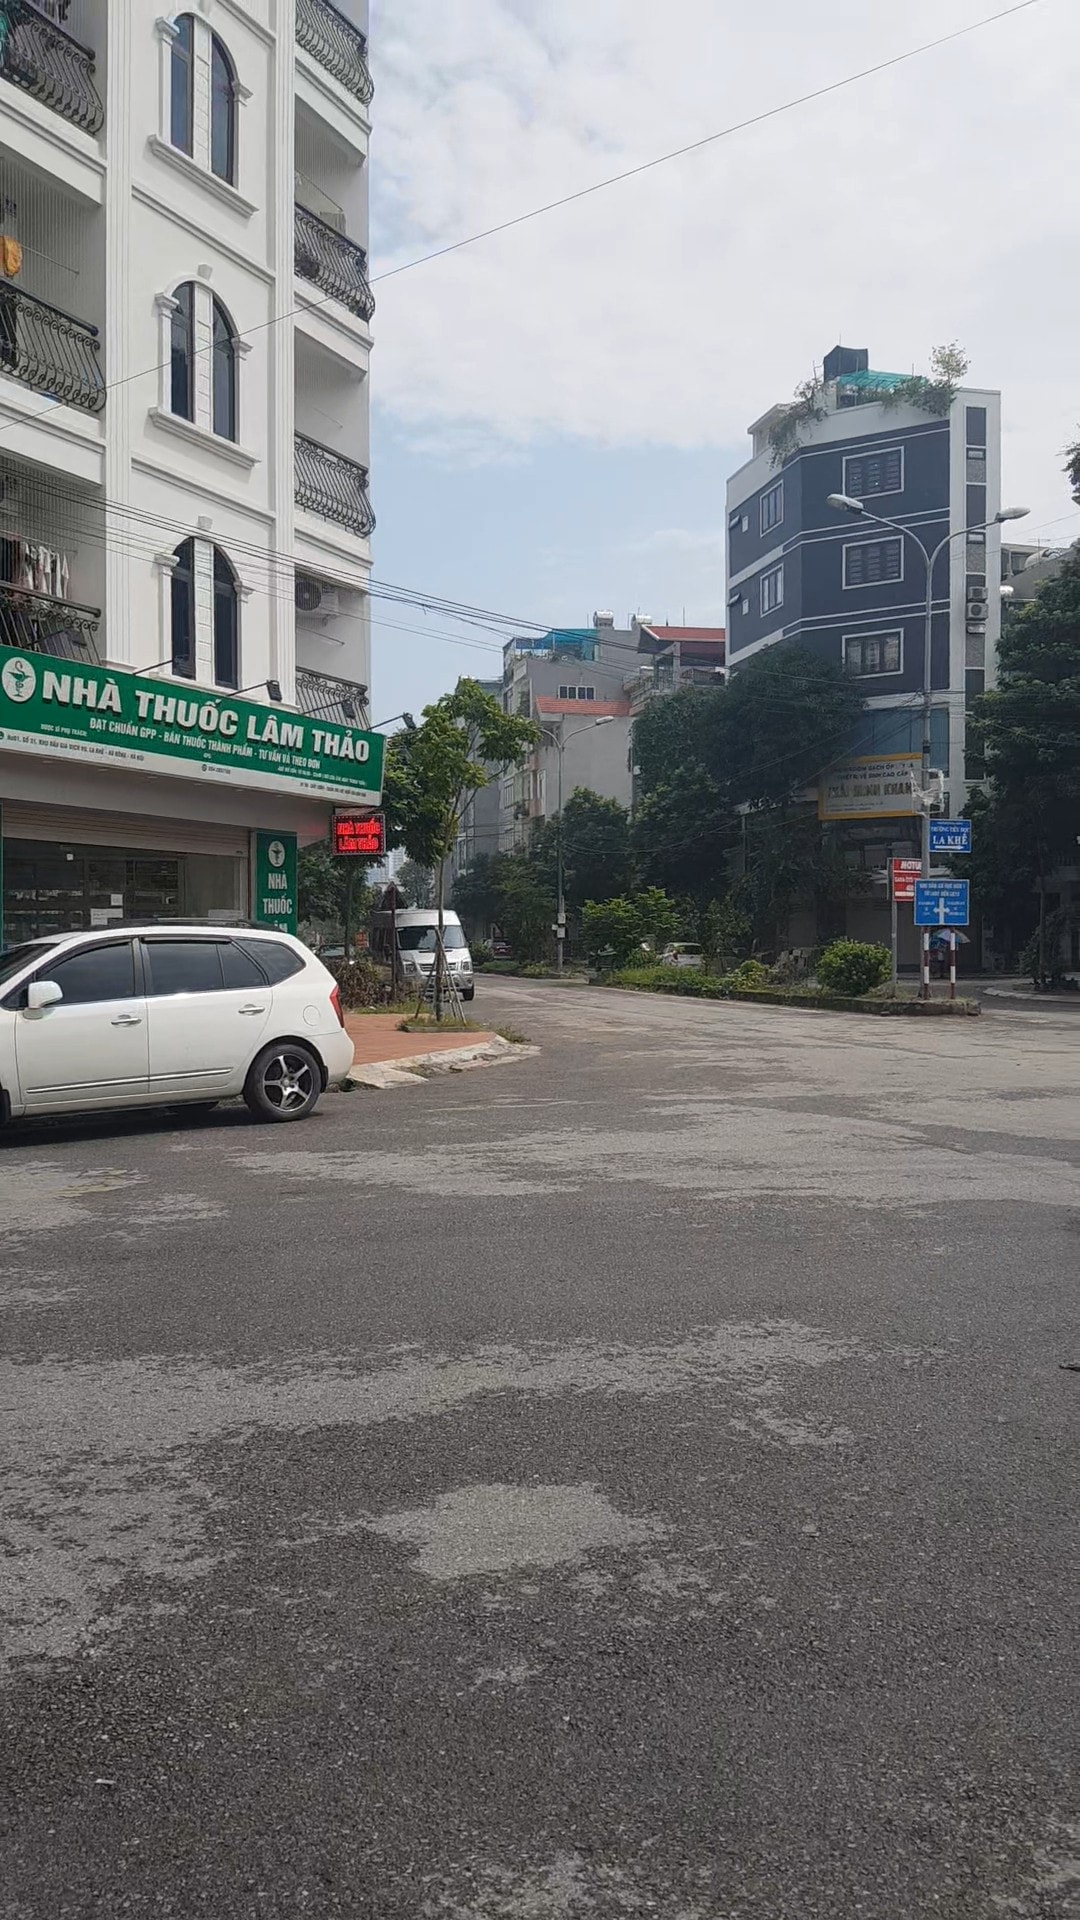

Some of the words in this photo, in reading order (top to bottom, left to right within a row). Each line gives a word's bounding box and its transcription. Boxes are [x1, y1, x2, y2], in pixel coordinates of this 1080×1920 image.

[42, 670, 122, 713] NHÀ
[135, 690, 239, 736] THUỐC
[247, 714, 304, 749] LÂM
[312, 729, 370, 762] THẢO
[90, 717, 107, 733] ĐẠT
[109, 720, 138, 737] CHUẨN
[139, 727, 156, 740] GPP
[163, 731, 181, 745] BÁN
[182, 735, 206, 749] THUỐC
[207, 739, 231, 754] THÀNH
[232, 743, 253, 757] PHẨM
[258, 749, 268, 760] TƯ
[268, 749, 281, 763] VẤN
[282, 752, 291, 765] VÀ
[291, 755, 307, 768] THEO
[933, 835, 945, 844] LA
[947, 833, 968, 845] KHÊ
[900, 860, 922, 870] MOTU
[268, 870, 288, 890] NHÀ
[263, 893, 292, 914] THUỐC
